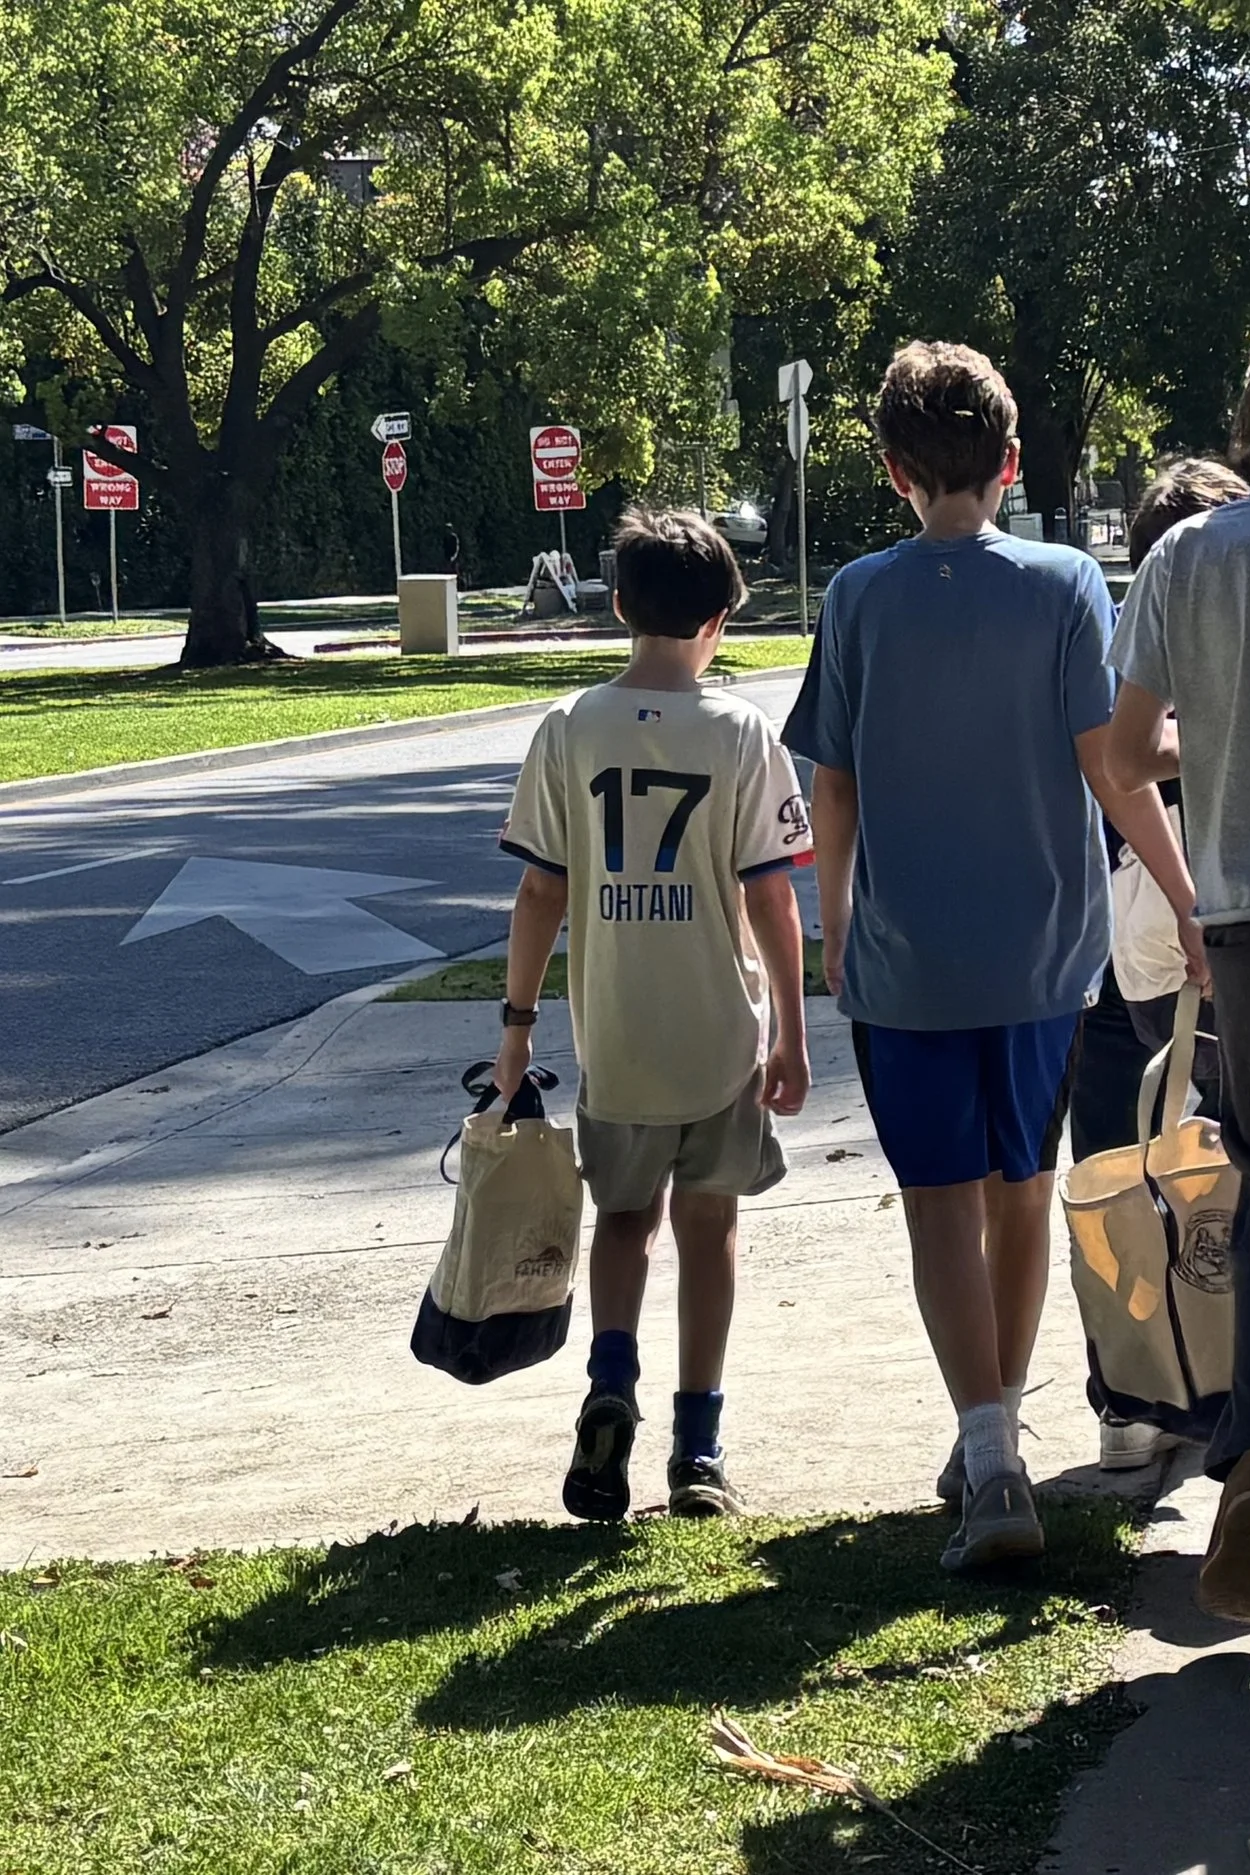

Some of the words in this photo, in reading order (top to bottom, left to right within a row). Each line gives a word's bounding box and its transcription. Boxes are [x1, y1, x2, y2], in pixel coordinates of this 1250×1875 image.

[537, 437, 550, 446] DO
[555, 436, 572, 446] NOT
[385, 457, 404, 475] STOP
[543, 459, 572, 468] ENTER
[90, 482, 132, 492] WRONG
[540, 482, 578, 492] WRONG
[100, 495, 122, 505] WAY
[549, 495, 570, 505] WAY
[590, 767, 711, 873] 17
[600, 884, 693, 921] OHTANI
